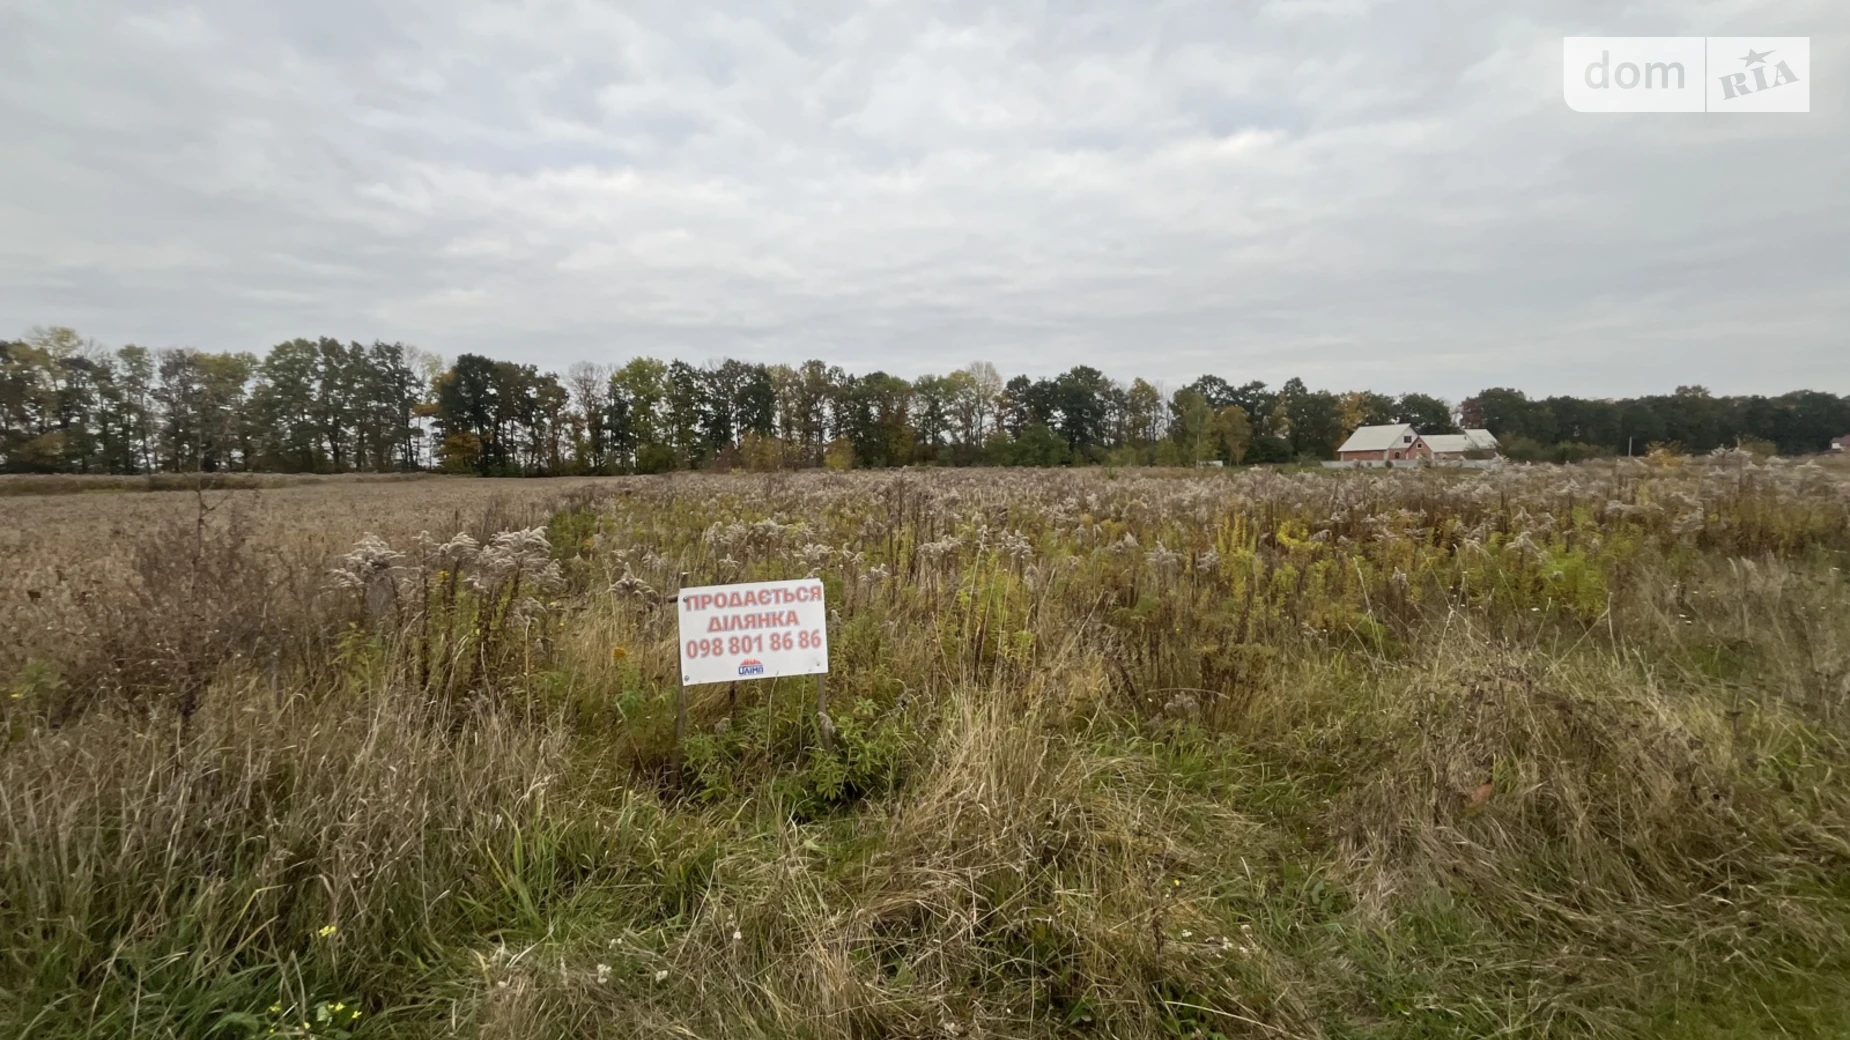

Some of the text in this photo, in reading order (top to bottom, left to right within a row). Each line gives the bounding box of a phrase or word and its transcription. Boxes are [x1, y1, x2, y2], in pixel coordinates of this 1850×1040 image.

[685, 585, 822, 612] ПРОДАЄТЬСЯ
[707, 610, 800, 633] ДІЛЯНКА
[686, 630, 821, 659] 098 801 86 86
